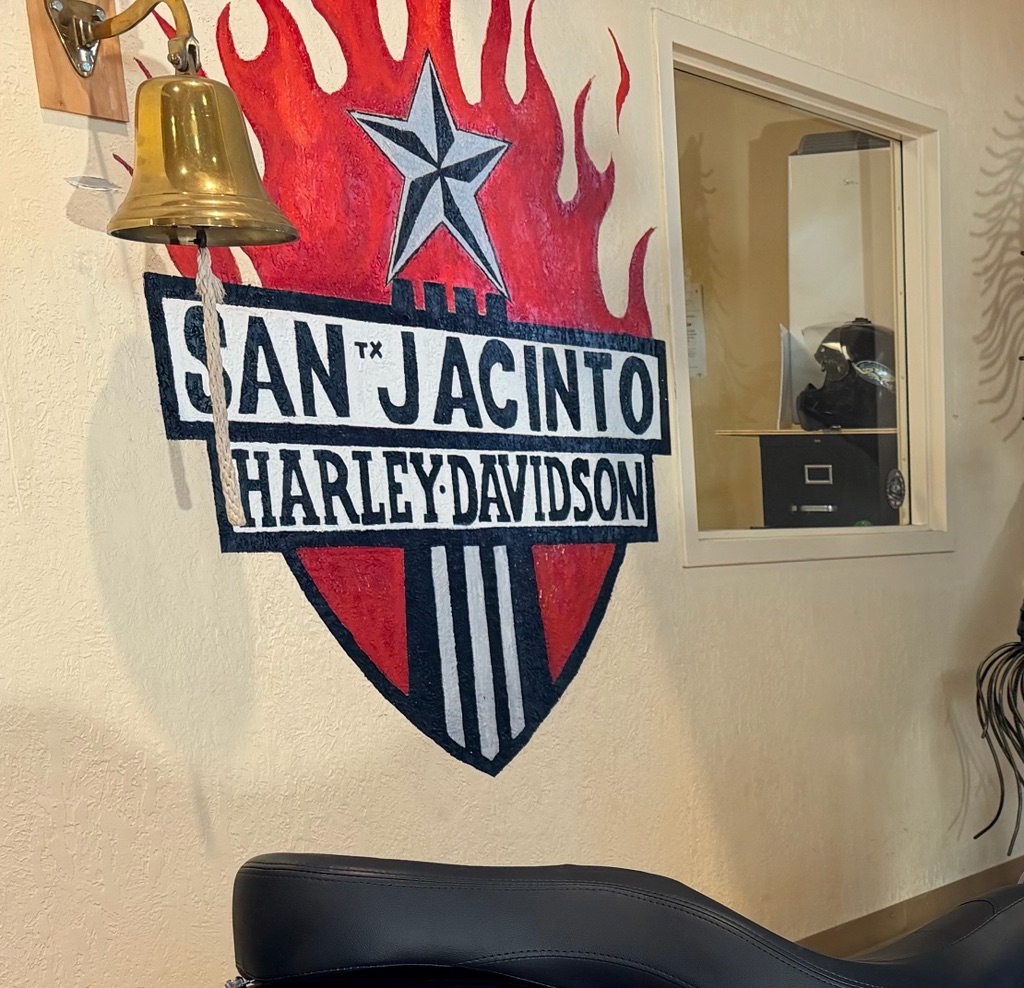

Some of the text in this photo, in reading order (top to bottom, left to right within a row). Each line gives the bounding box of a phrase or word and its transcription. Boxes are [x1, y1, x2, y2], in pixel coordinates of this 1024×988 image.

[184, 304, 655, 435] SAN TX JACINTO
